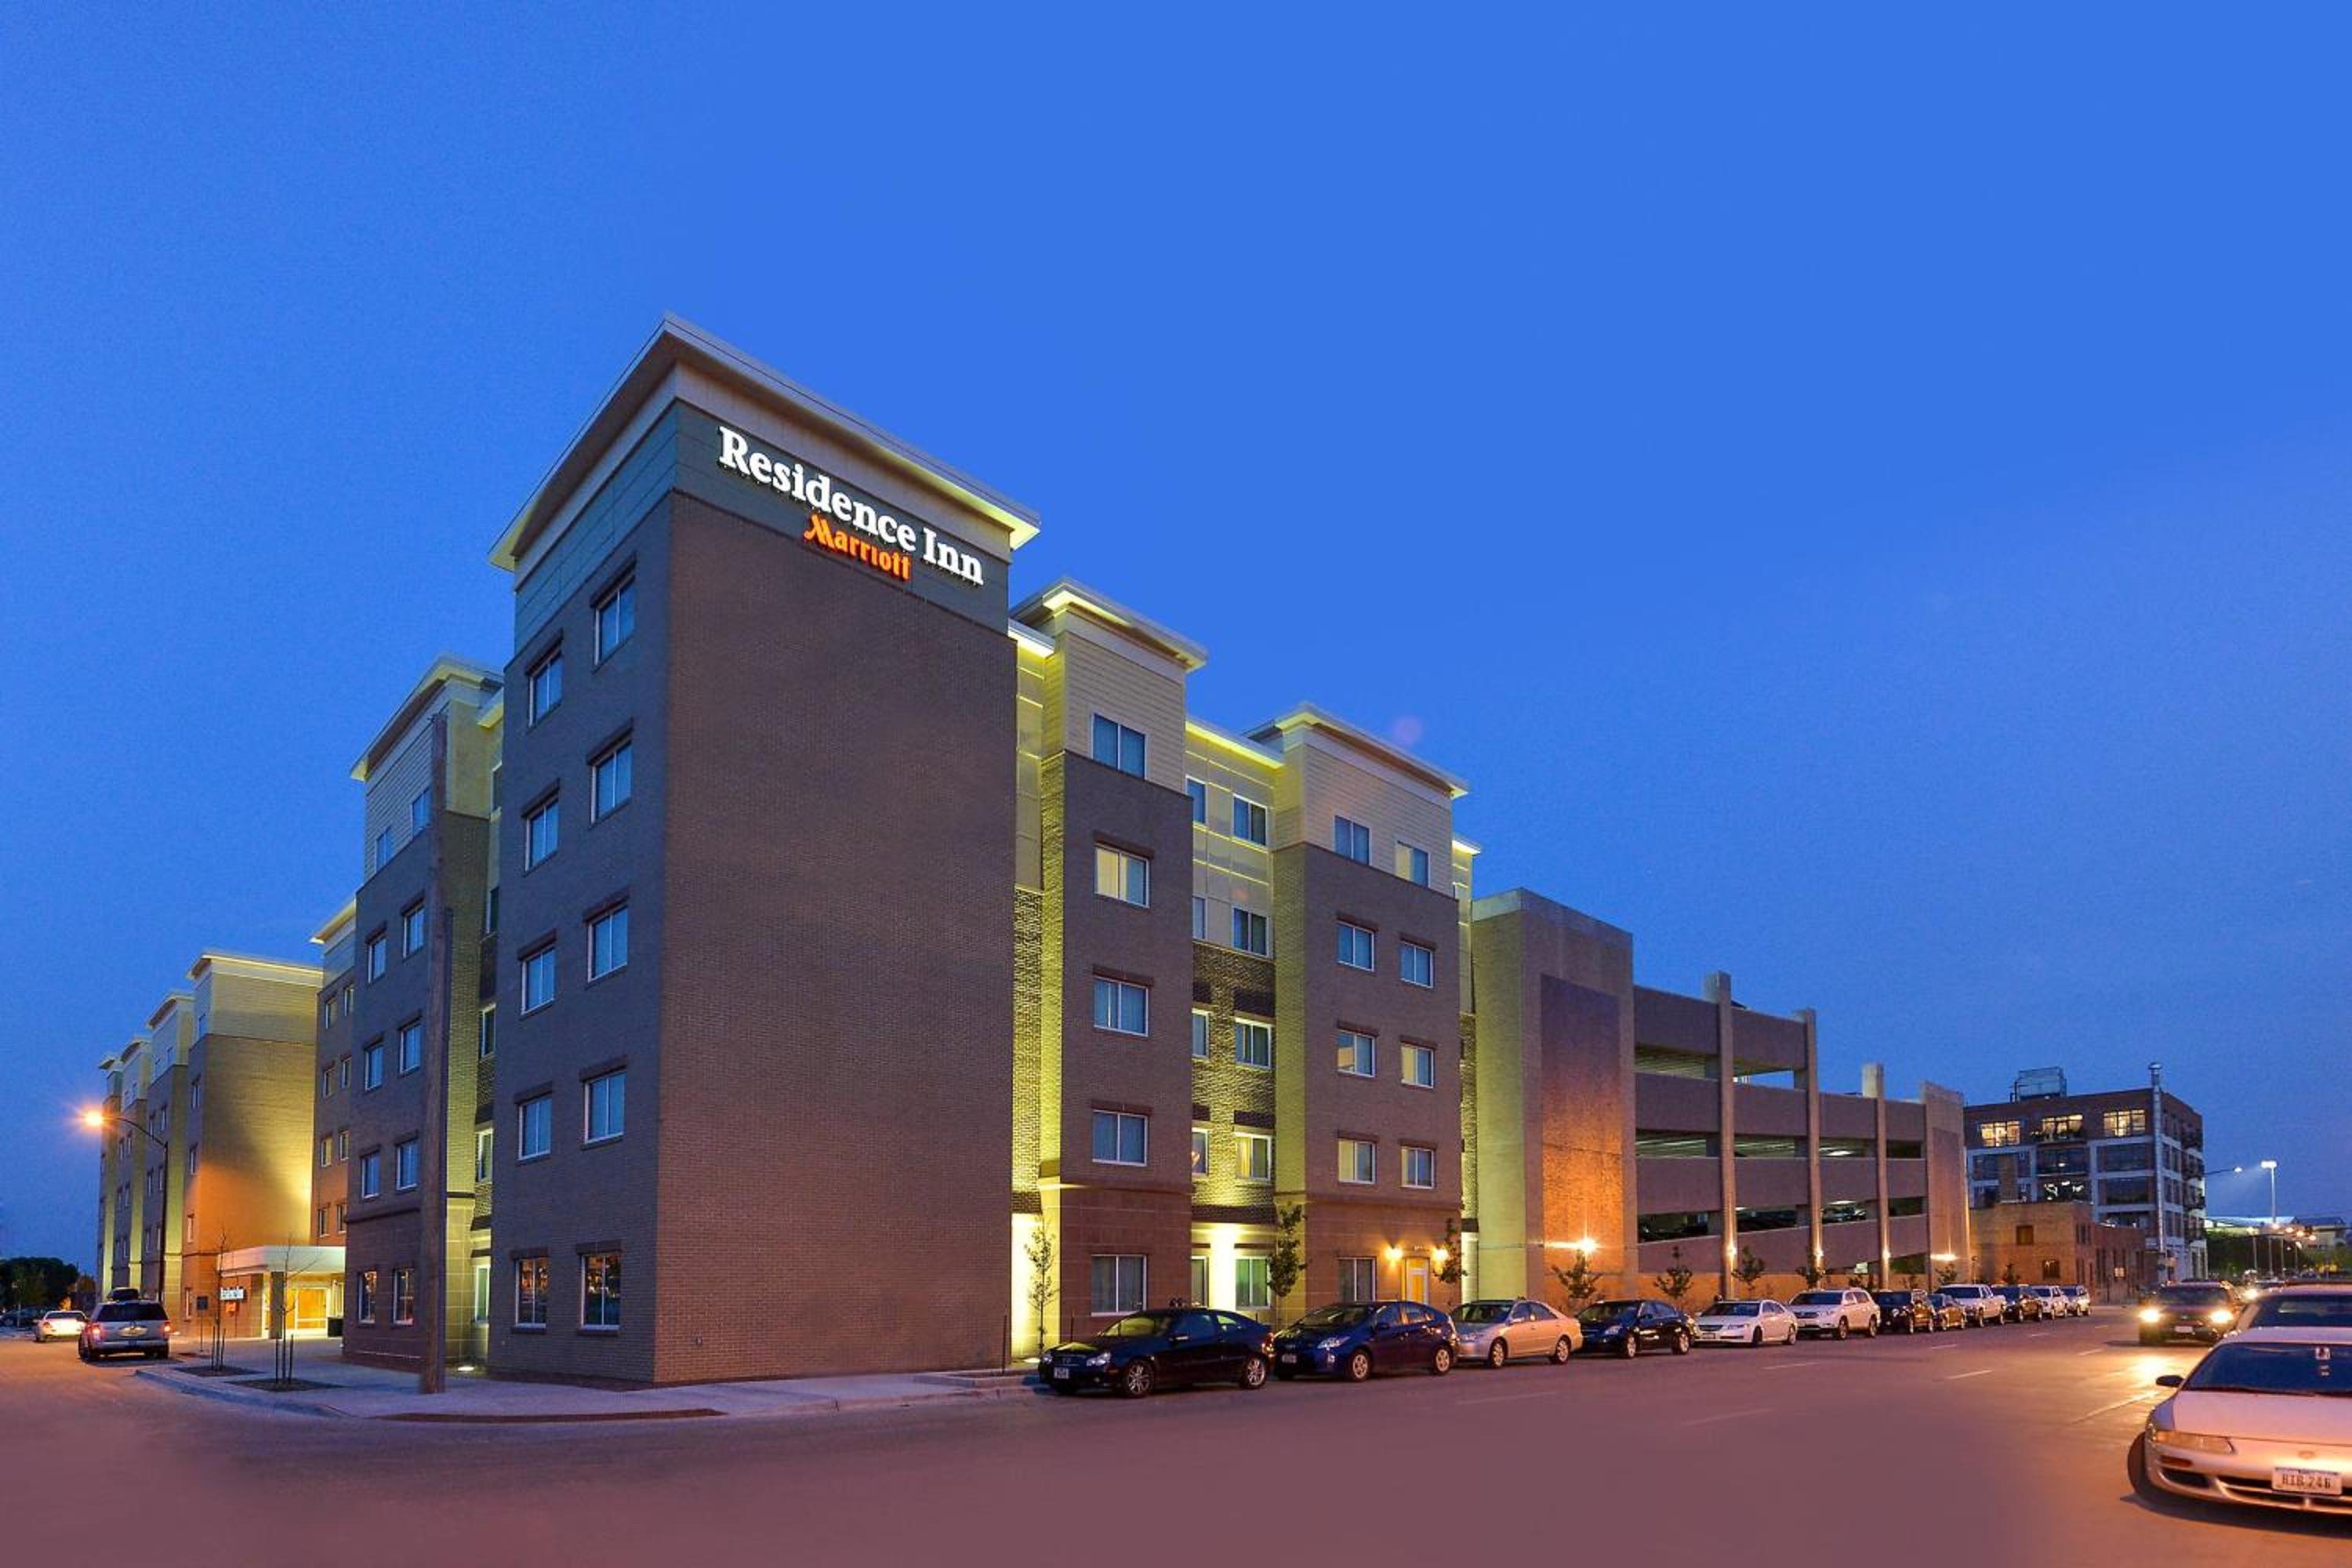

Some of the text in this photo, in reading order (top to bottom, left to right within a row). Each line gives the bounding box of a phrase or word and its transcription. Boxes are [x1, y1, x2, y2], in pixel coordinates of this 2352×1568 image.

[718, 426, 984, 585] Residence Inn
[803, 514, 911, 579] Marriott
